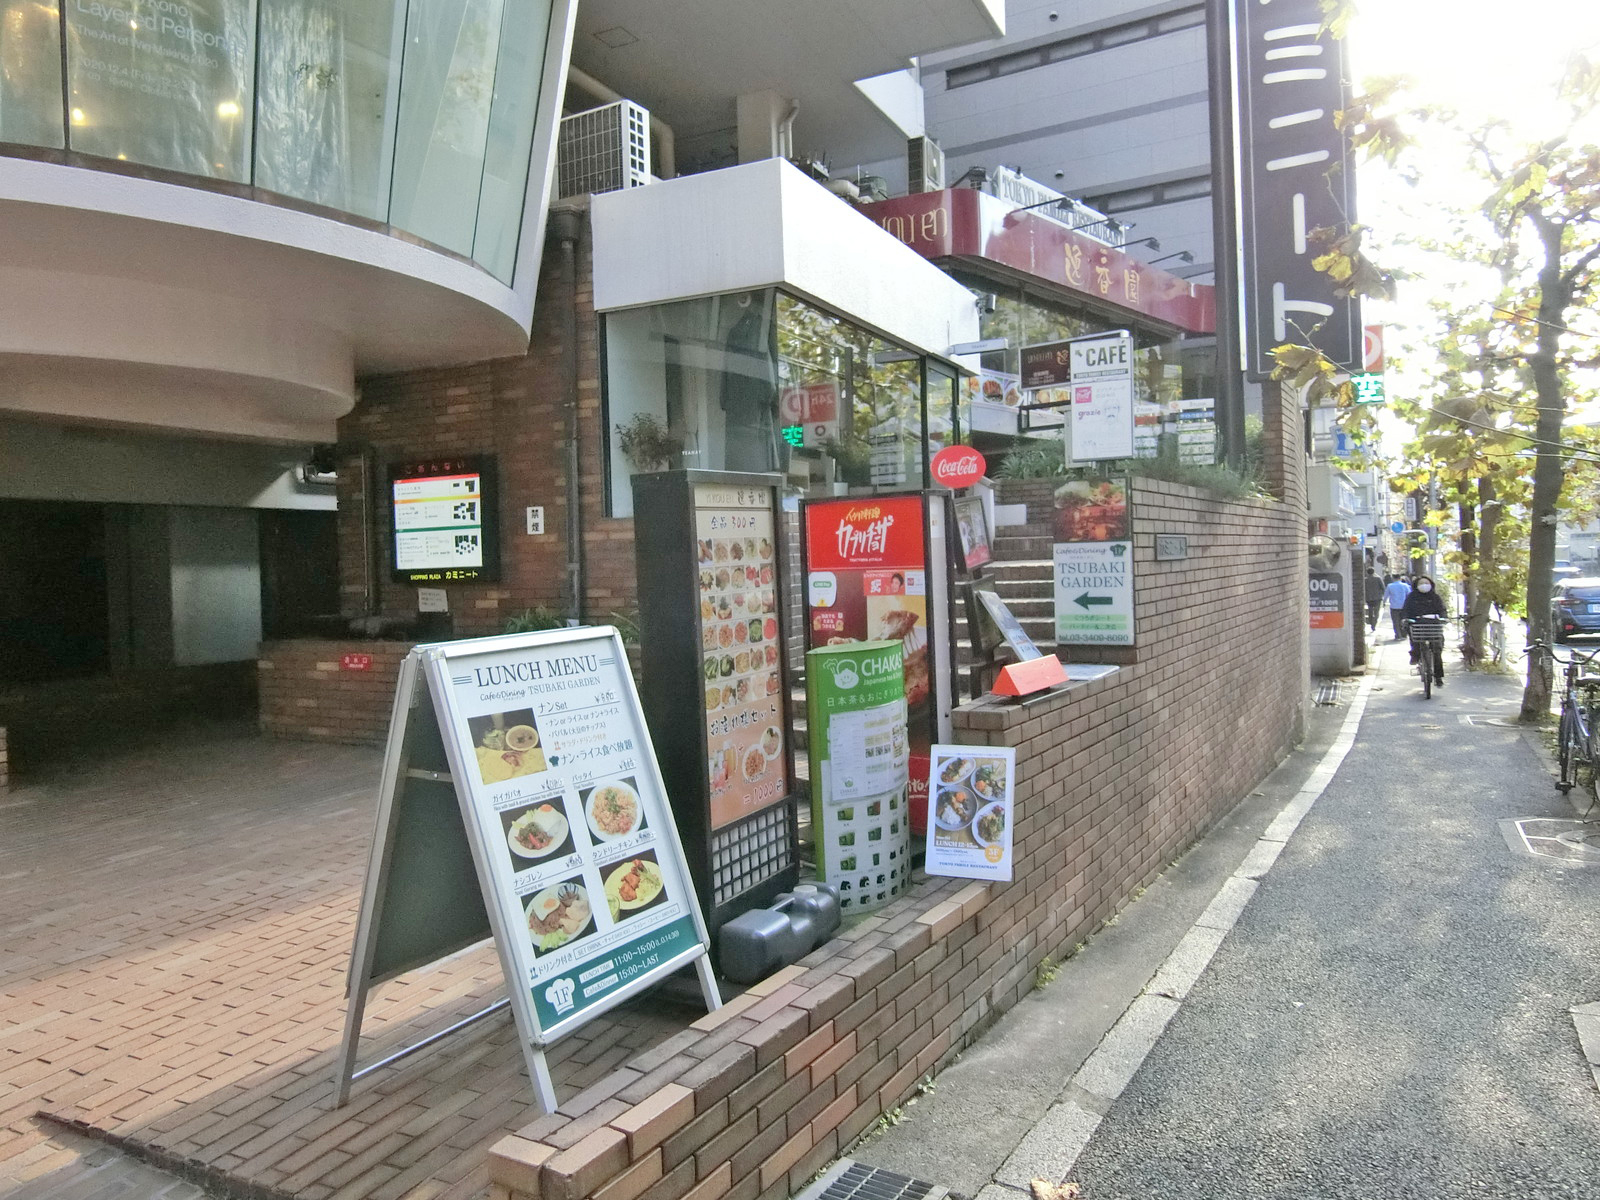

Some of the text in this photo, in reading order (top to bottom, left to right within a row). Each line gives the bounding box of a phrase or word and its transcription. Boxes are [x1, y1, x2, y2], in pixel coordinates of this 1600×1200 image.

[1086, 340, 1128, 367] CAFÉ
[937, 456, 978, 478] Coca-Cola
[531, 508, 540, 532] 禁煙
[445, 570, 479, 579] カミニート
[1058, 561, 1126, 575] TSUBAKI
[1061, 576, 1125, 589] GARDEN
[474, 654, 599, 687] LUNCH MENU
[528, 681, 567, 695] TSUBAKI
[567, 676, 601, 690] GARDEN
[561, 739, 634, 765] ナン・ライス食べ放題
[592, 839, 633, 860] タンドリーチキン
[513, 871, 543, 887] ナシゴレン
[538, 952, 573, 975] ドリンク付き
[554, 986, 570, 1006] 1F
